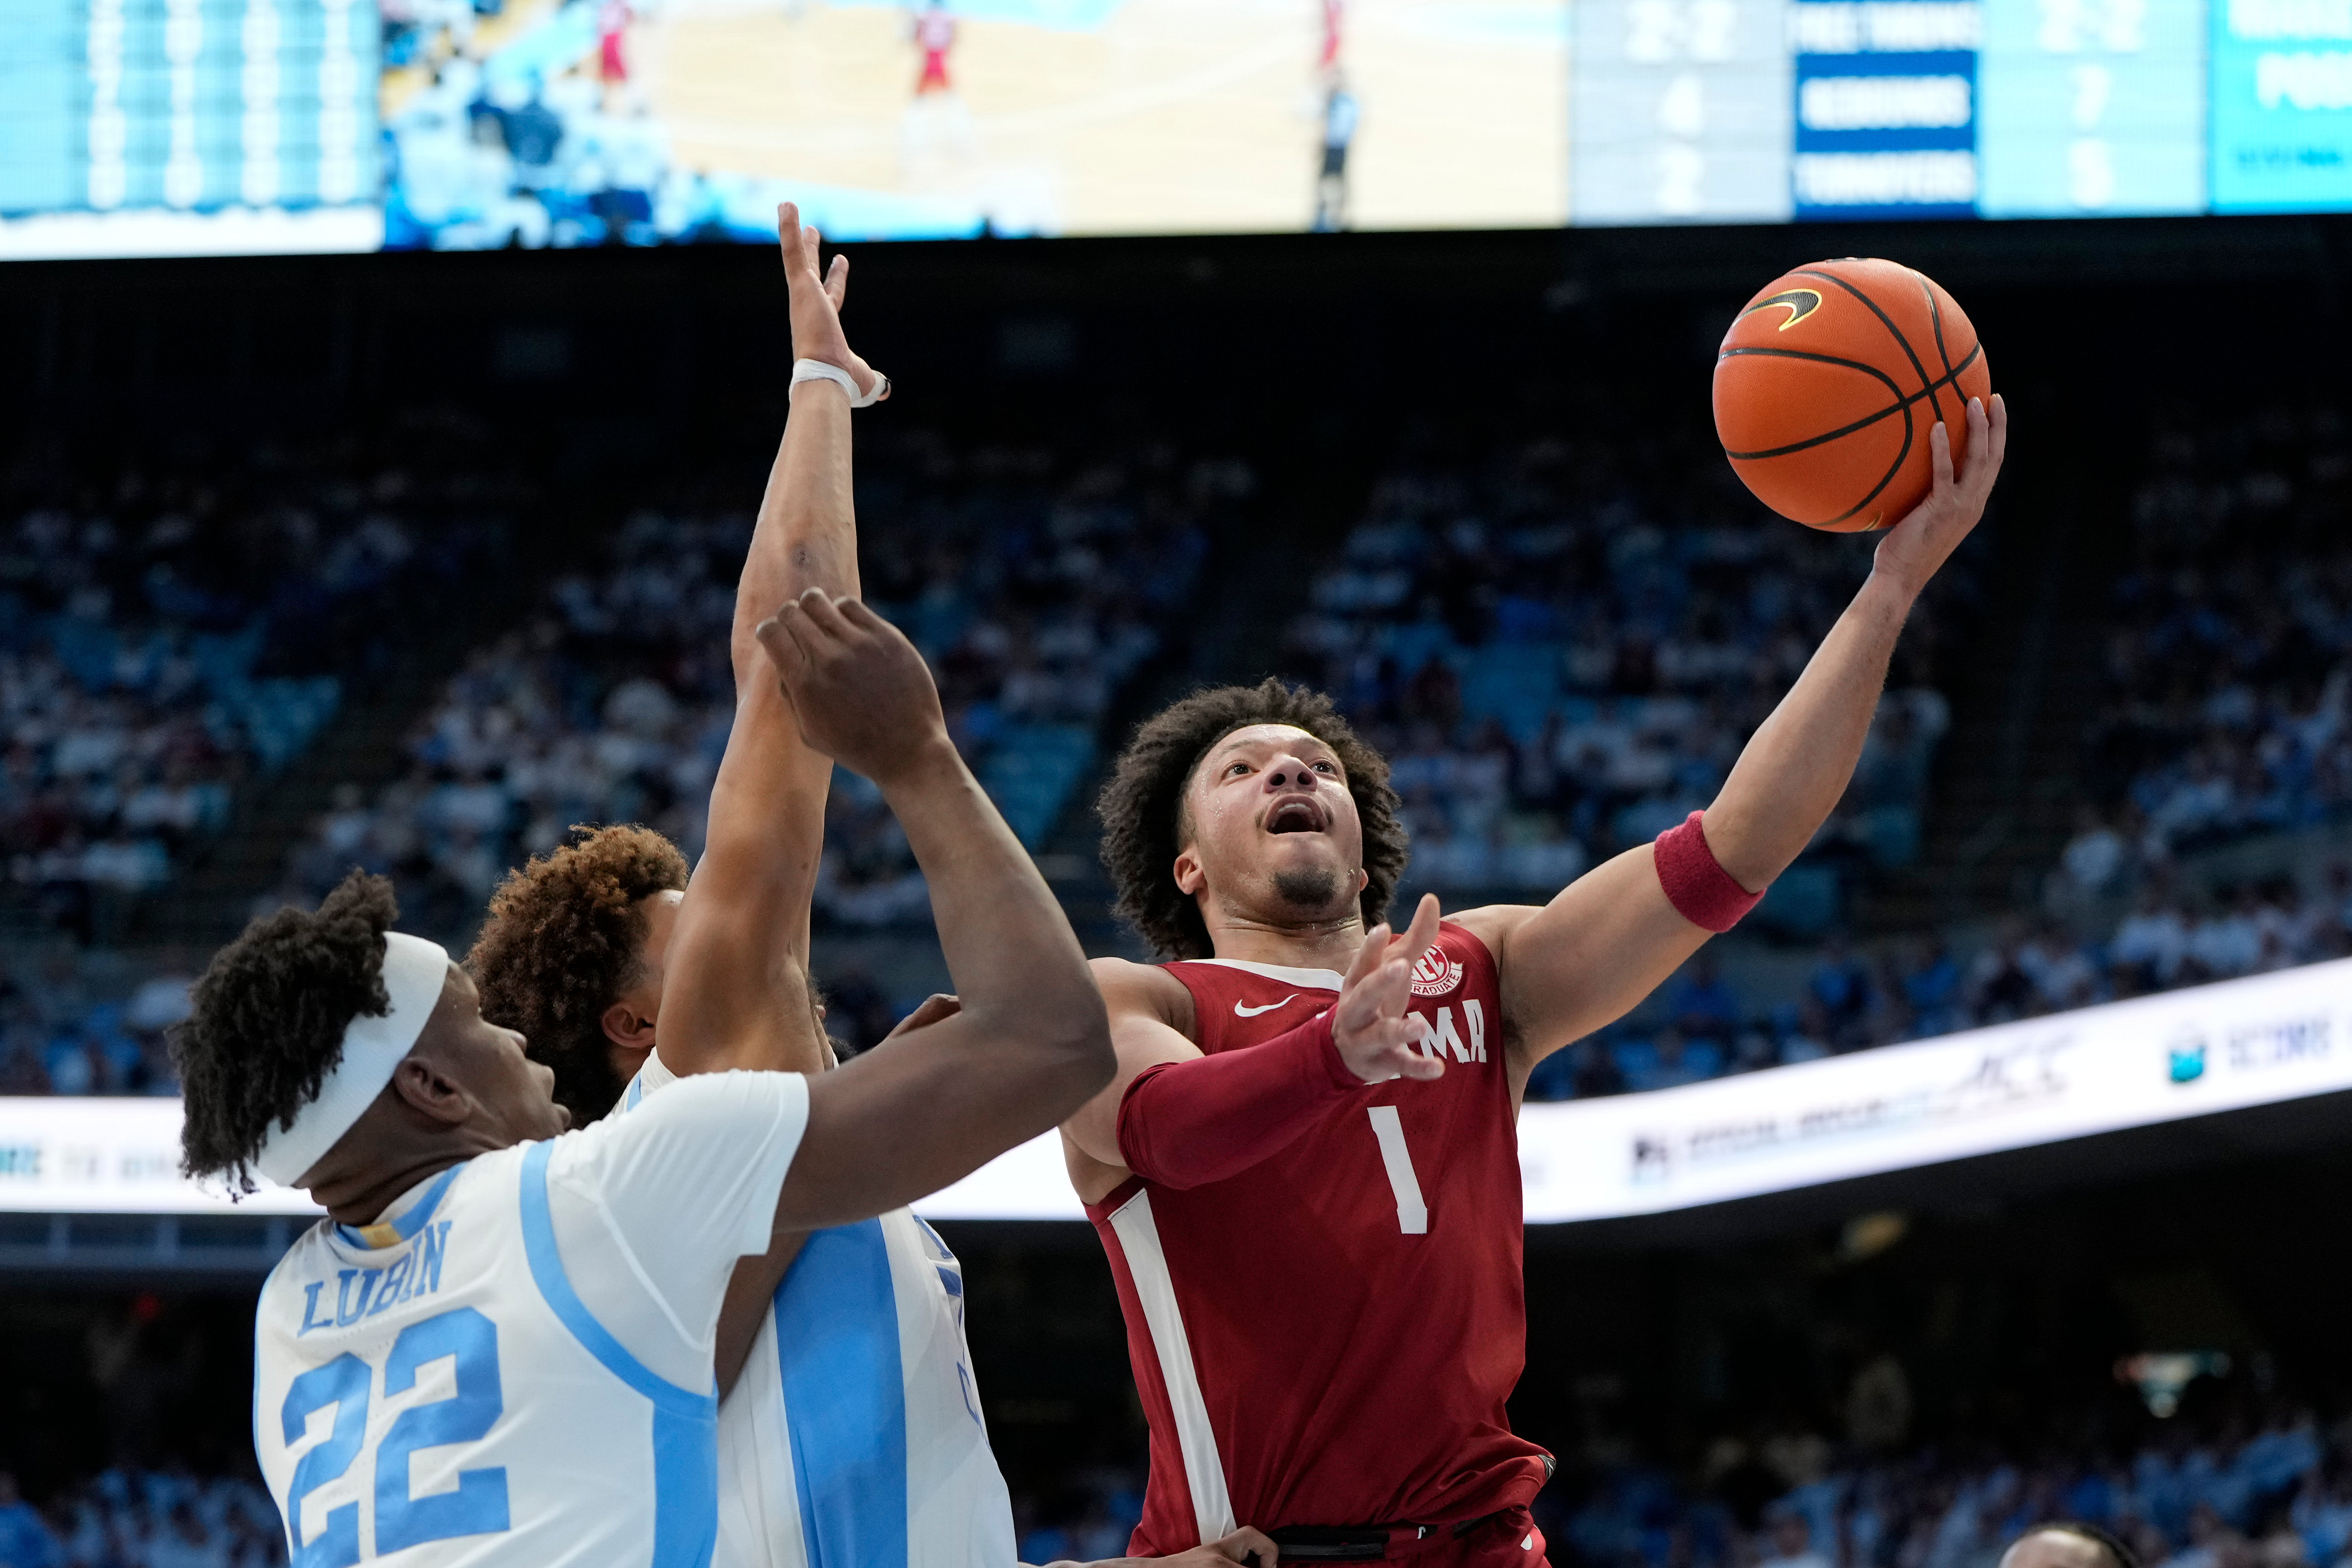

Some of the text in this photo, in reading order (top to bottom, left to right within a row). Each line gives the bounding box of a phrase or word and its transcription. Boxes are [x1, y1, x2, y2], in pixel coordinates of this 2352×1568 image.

[1411, 971, 1460, 994] RADUATE
[1367, 1105, 1427, 1235] 1
[298, 1221, 453, 1338] LUBIN
[281, 1306, 511, 1568] 22
